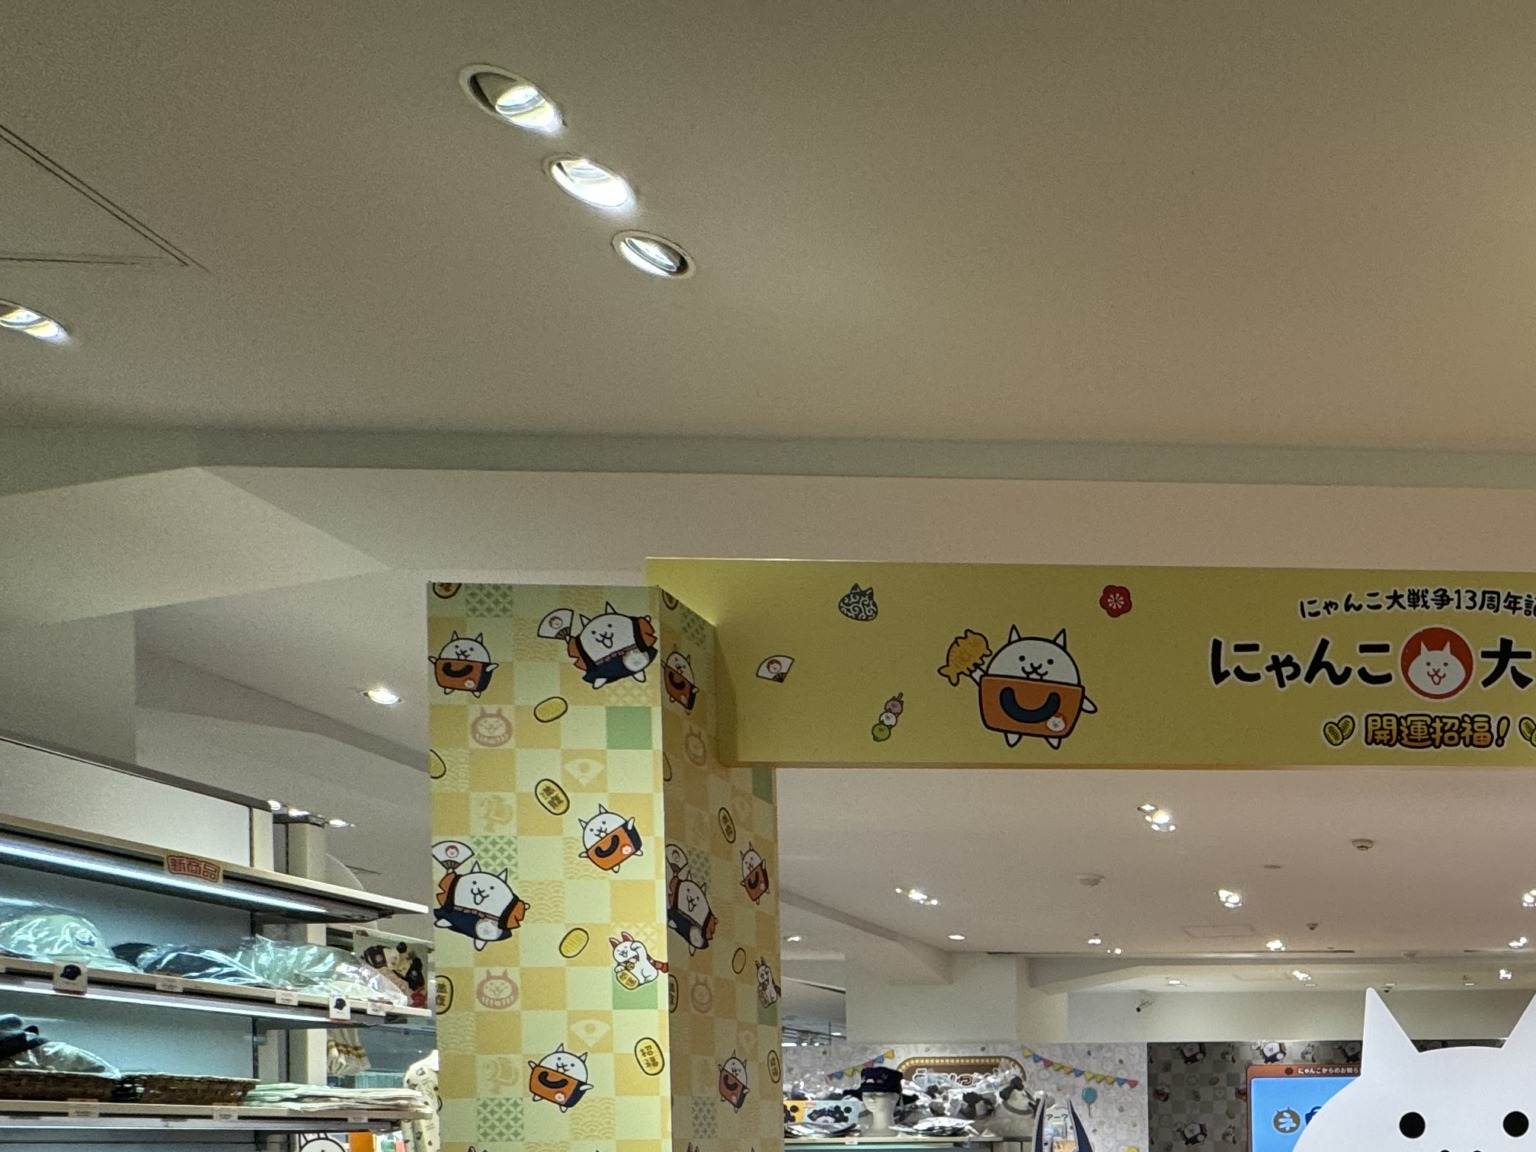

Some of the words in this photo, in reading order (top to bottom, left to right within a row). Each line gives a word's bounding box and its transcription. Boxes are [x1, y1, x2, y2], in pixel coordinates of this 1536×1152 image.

[1210, 637, 1392, 689] にゃんこ
[170, 858, 217, 880] 新商品
